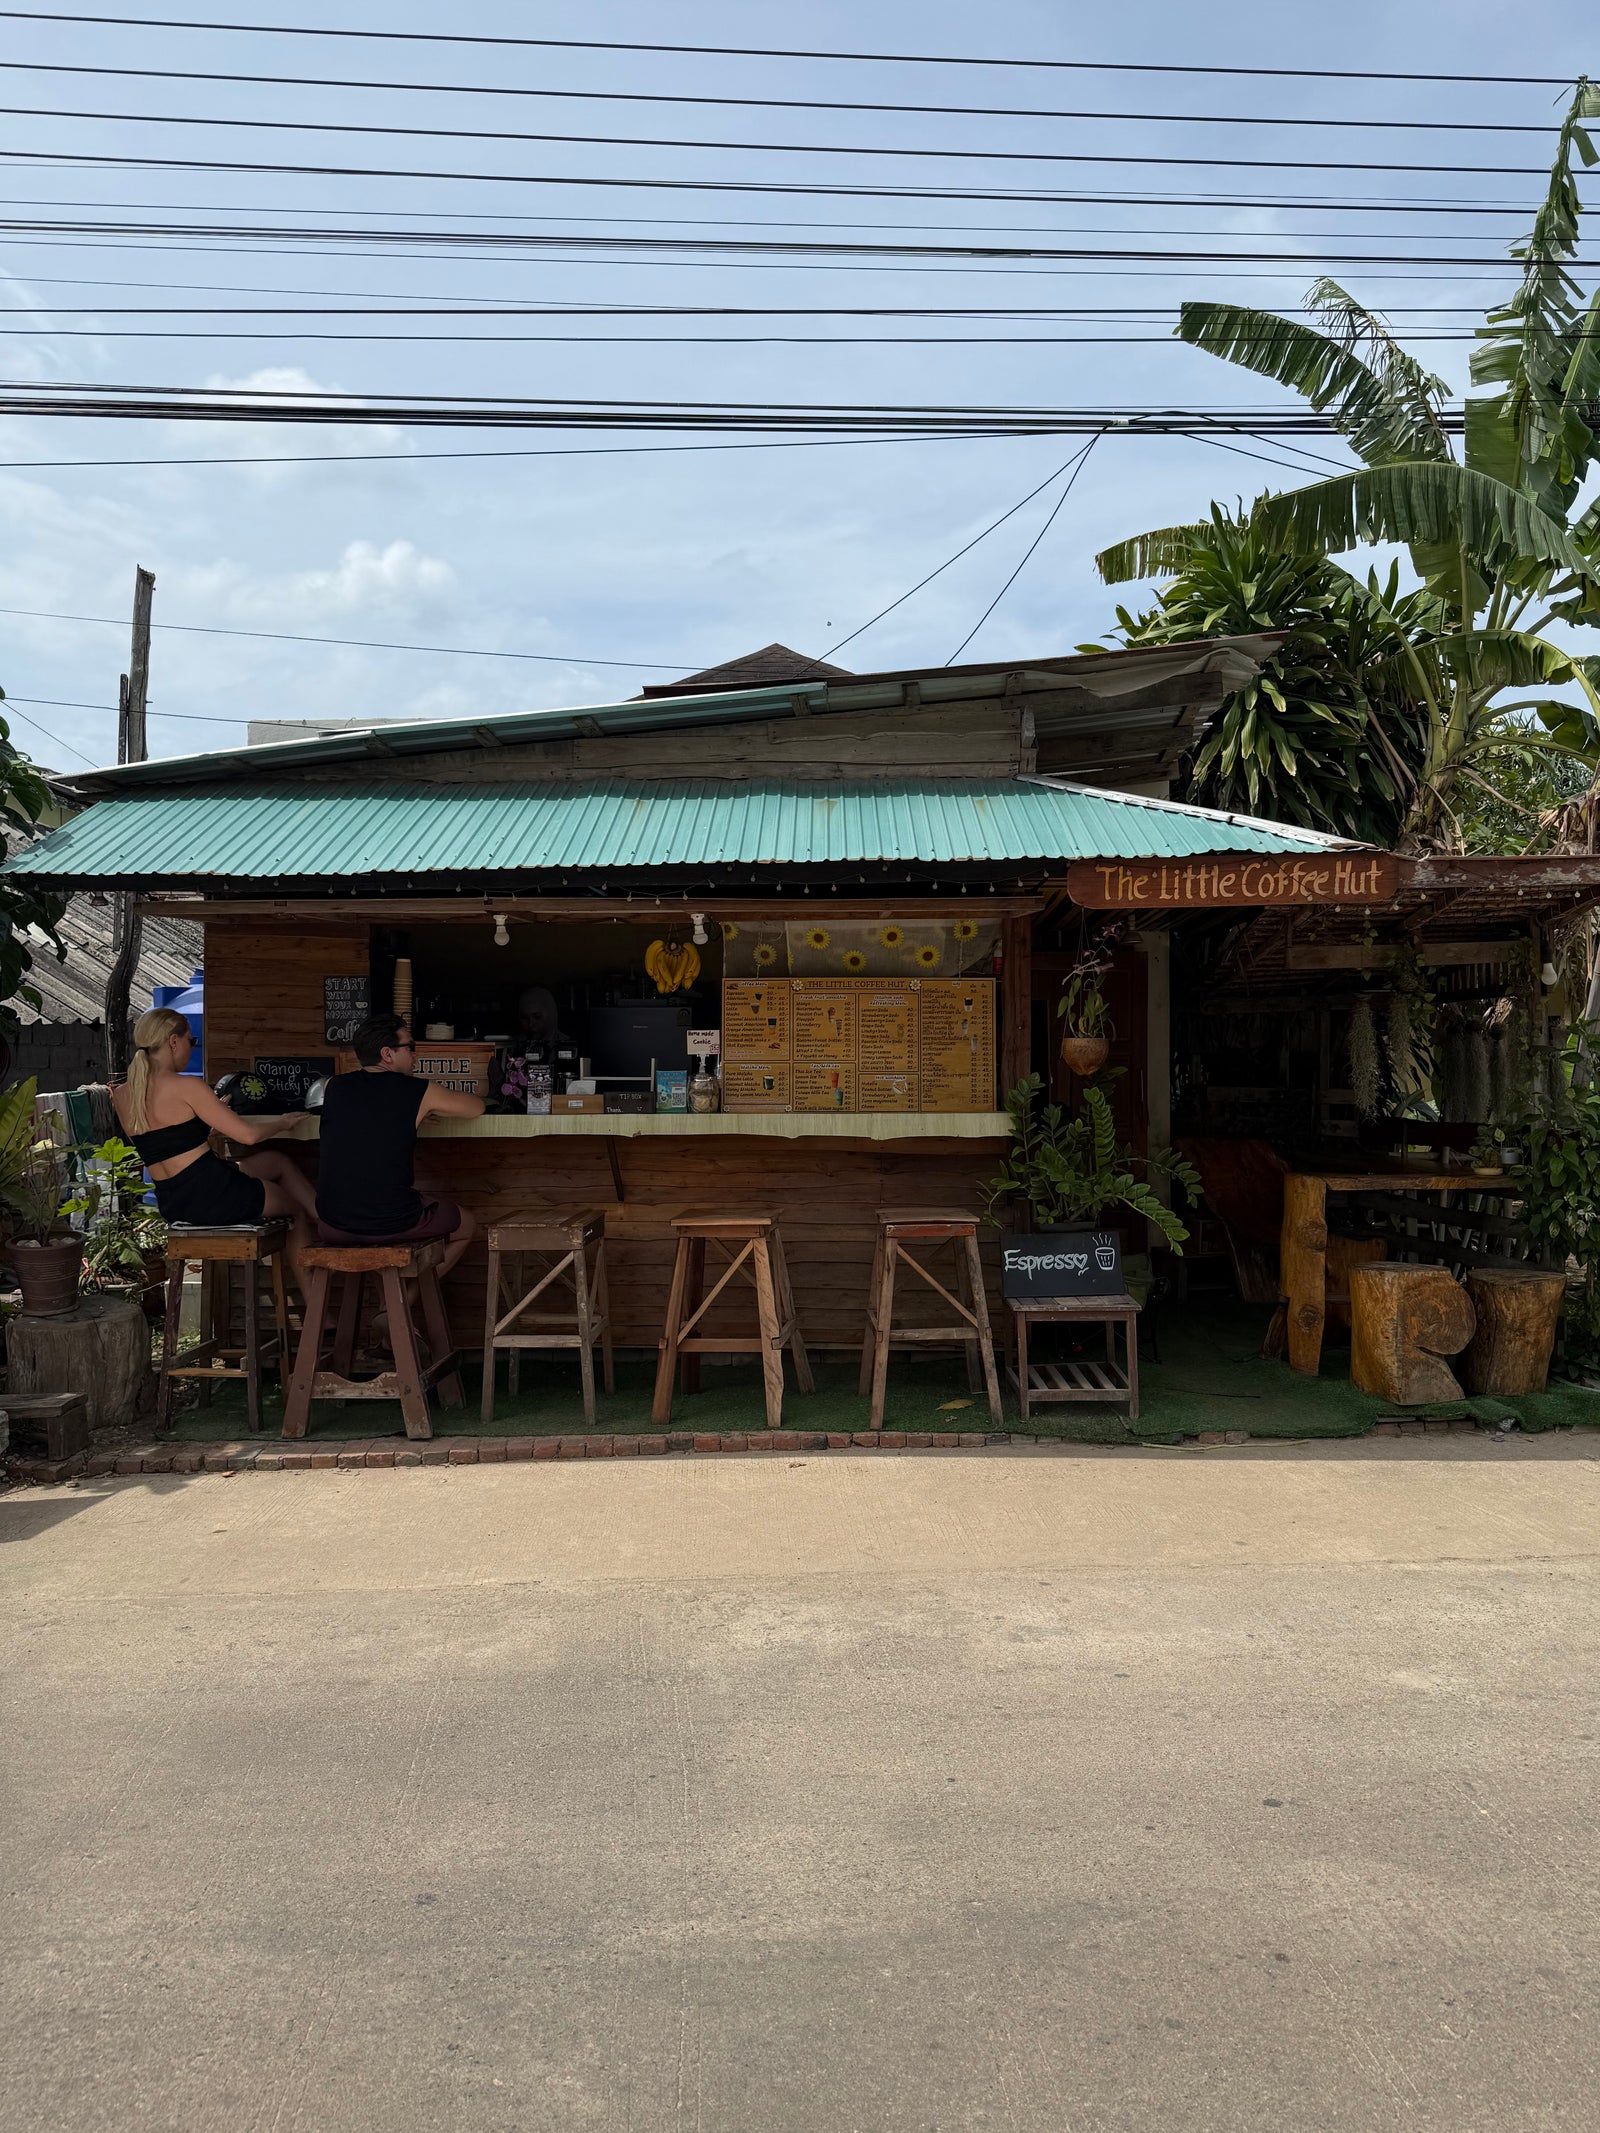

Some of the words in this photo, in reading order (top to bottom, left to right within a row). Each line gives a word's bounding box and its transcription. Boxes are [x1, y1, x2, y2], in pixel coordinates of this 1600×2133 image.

[1099, 865, 1149, 900] The
[1160, 864, 1237, 900] Little
[1242, 861, 1330, 898] Coffee
[1334, 859, 1384, 895] Hut
[325, 977, 367, 991] START
[325, 991, 351, 1000] WITH
[325, 1001, 352, 1010] YOUR
[326, 1010, 368, 1019] MORNING
[259, 1063, 301, 1084] Mango
[267, 1078, 300, 1096] Sticky
